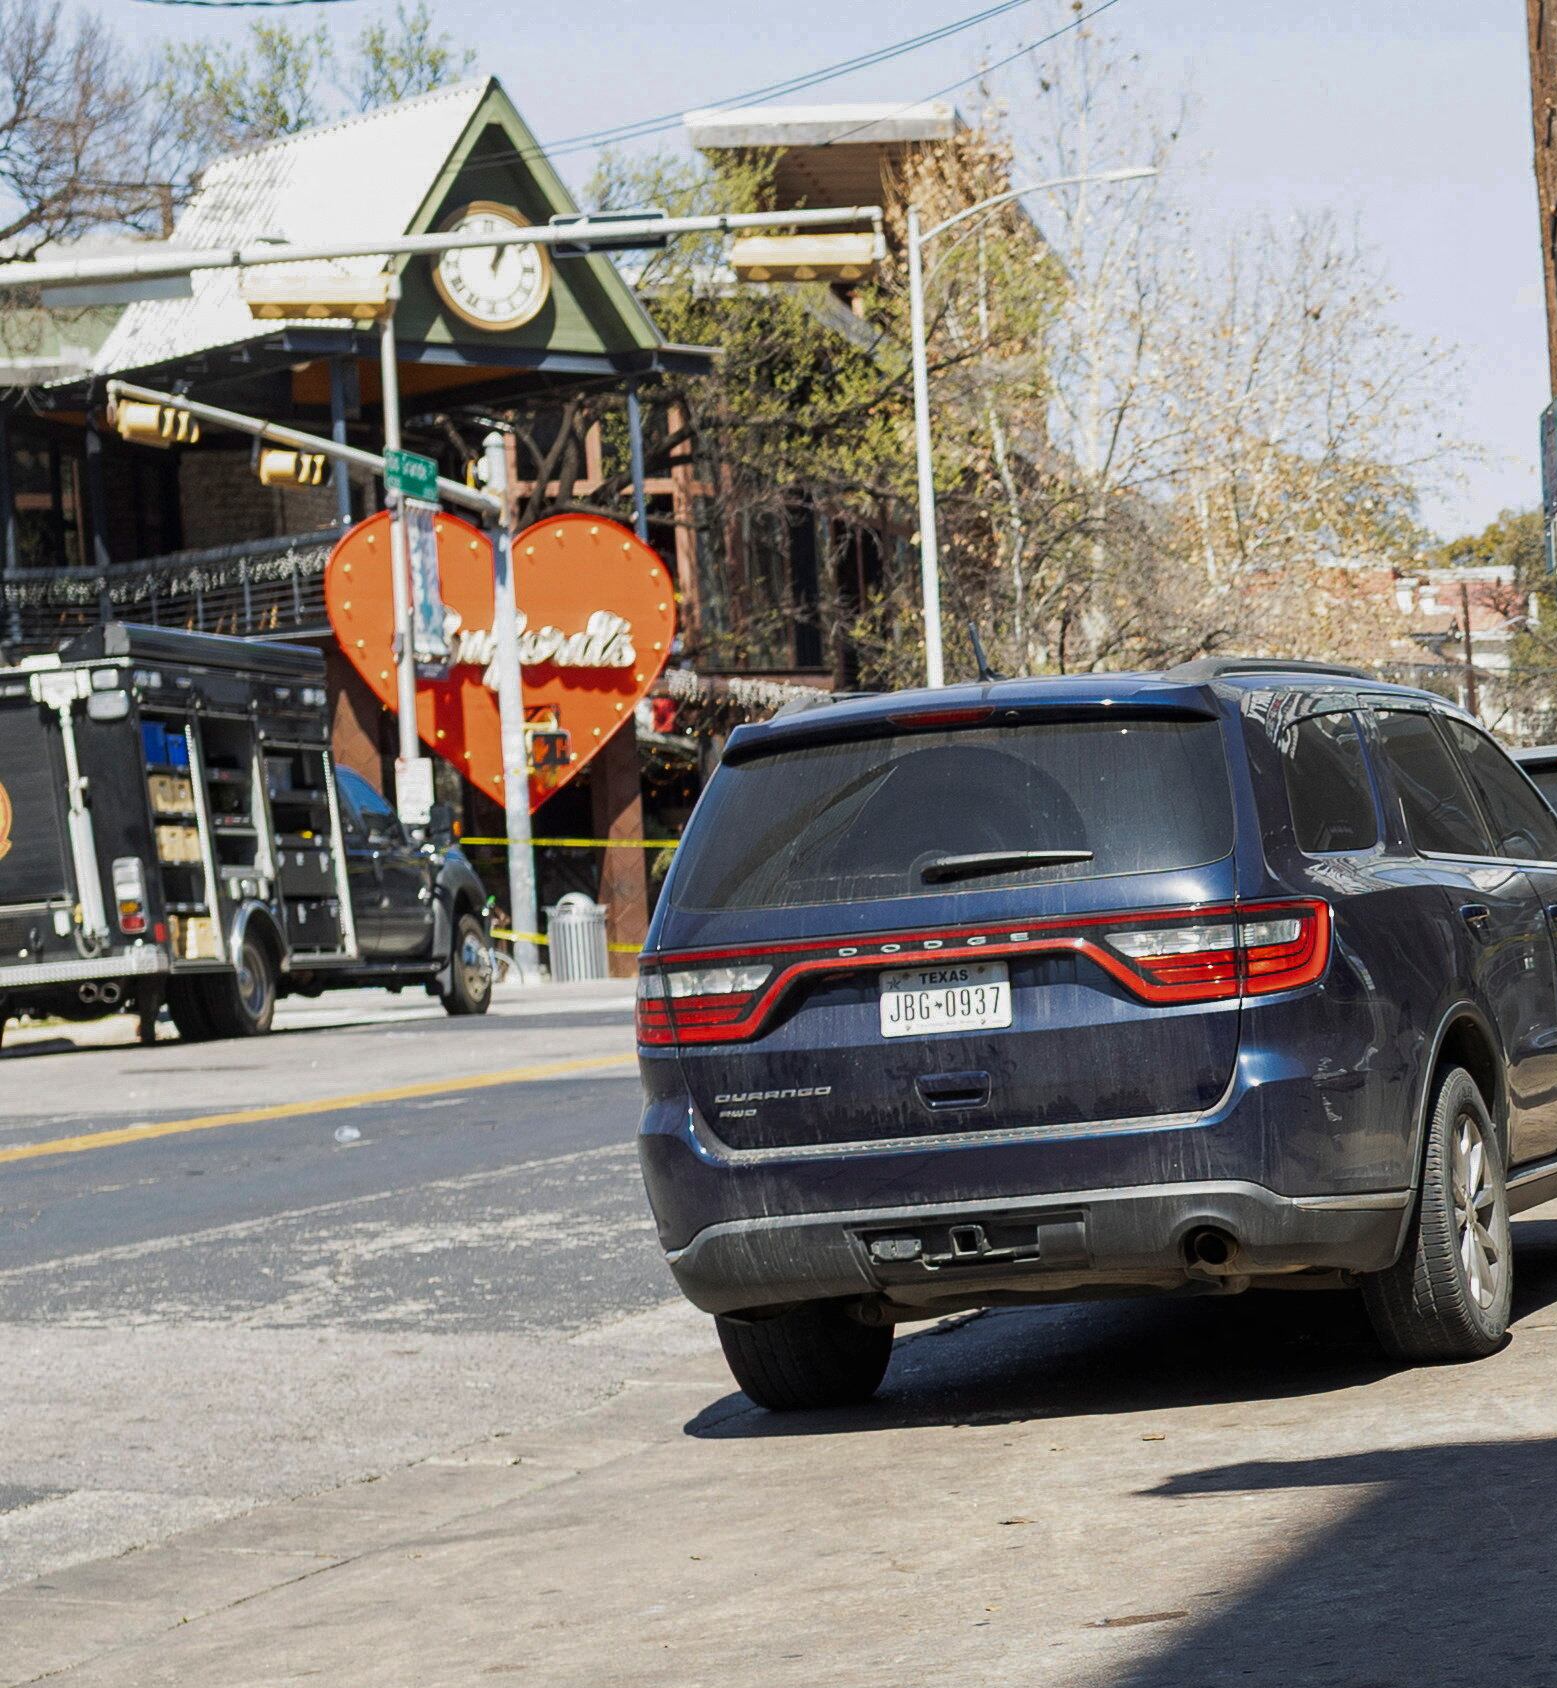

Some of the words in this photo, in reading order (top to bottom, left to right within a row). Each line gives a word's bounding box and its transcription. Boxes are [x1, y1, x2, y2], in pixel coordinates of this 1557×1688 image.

[838, 932, 1030, 957] DODGE
[918, 969, 969, 985] TEXAS
[714, 1086, 831, 1104] DURANGO
[719, 1109, 757, 1118] AWD
